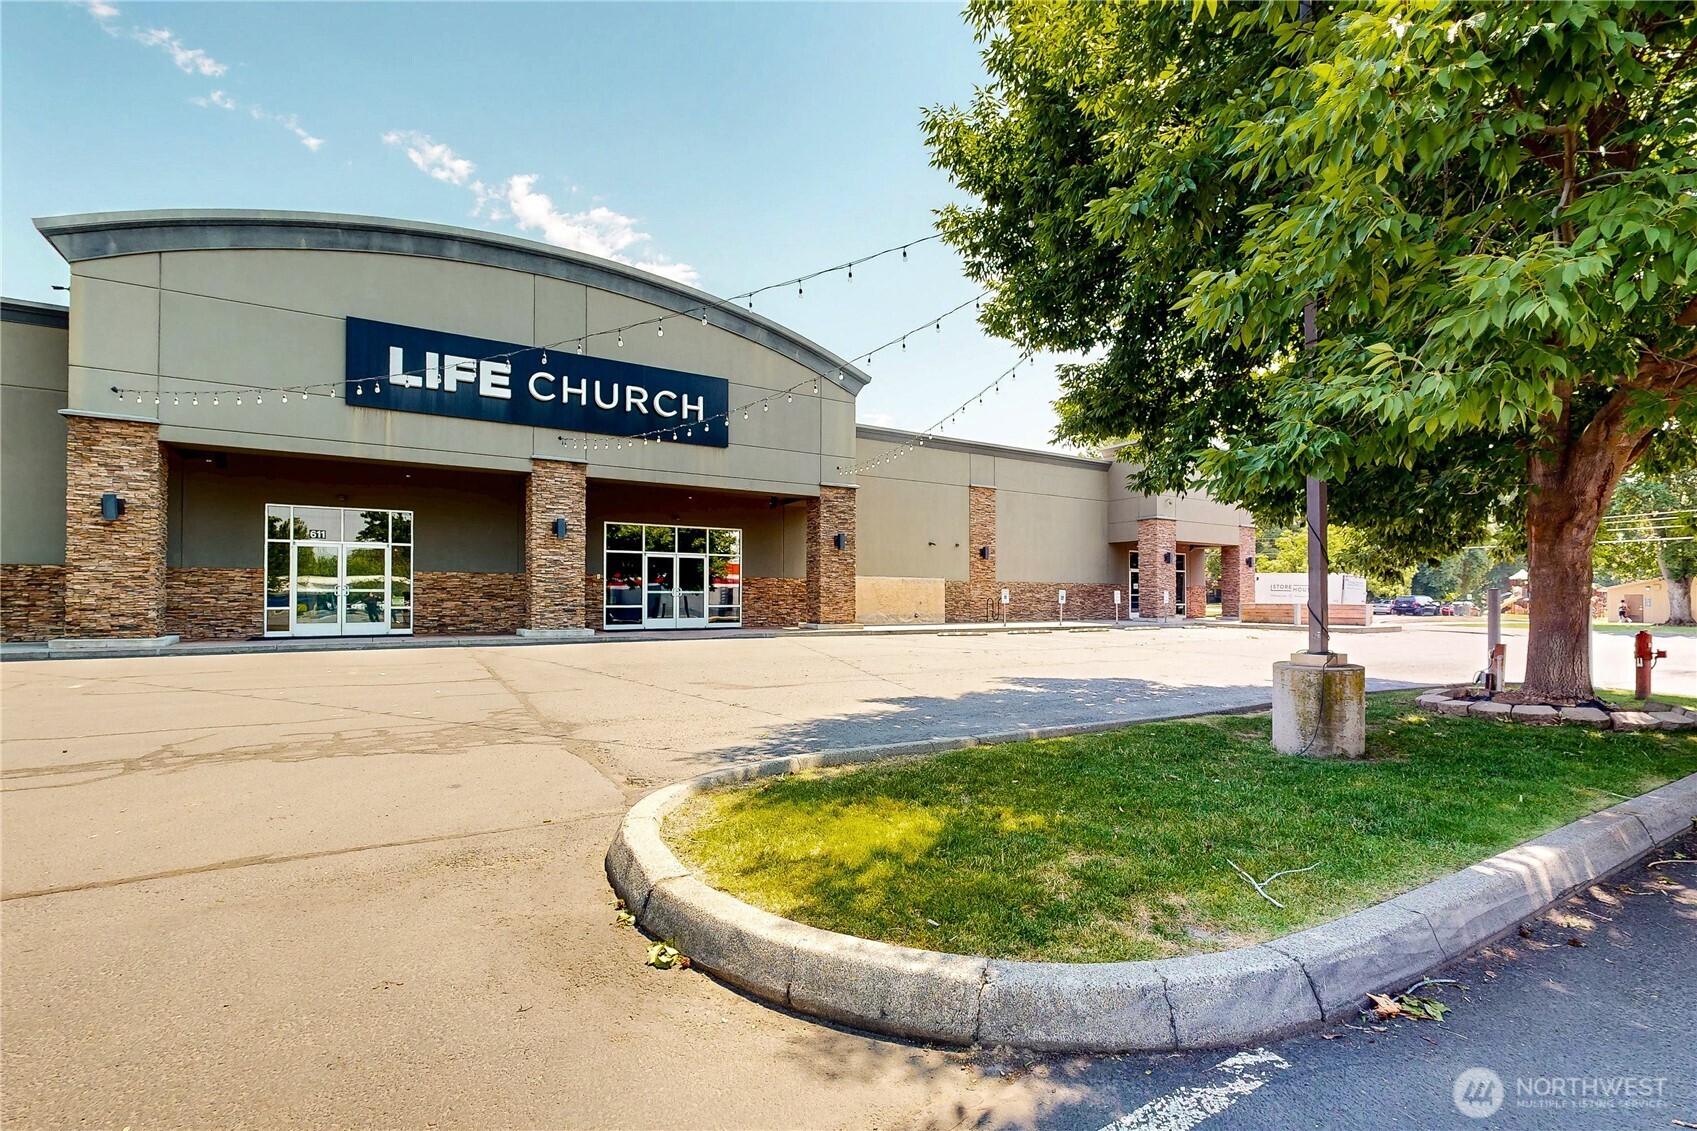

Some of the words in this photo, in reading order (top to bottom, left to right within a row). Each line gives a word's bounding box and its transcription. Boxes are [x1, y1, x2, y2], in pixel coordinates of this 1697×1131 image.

[389, 346, 511, 399] LIFE
[528, 371, 704, 422] CHURCH
[309, 530, 326, 539] 611
